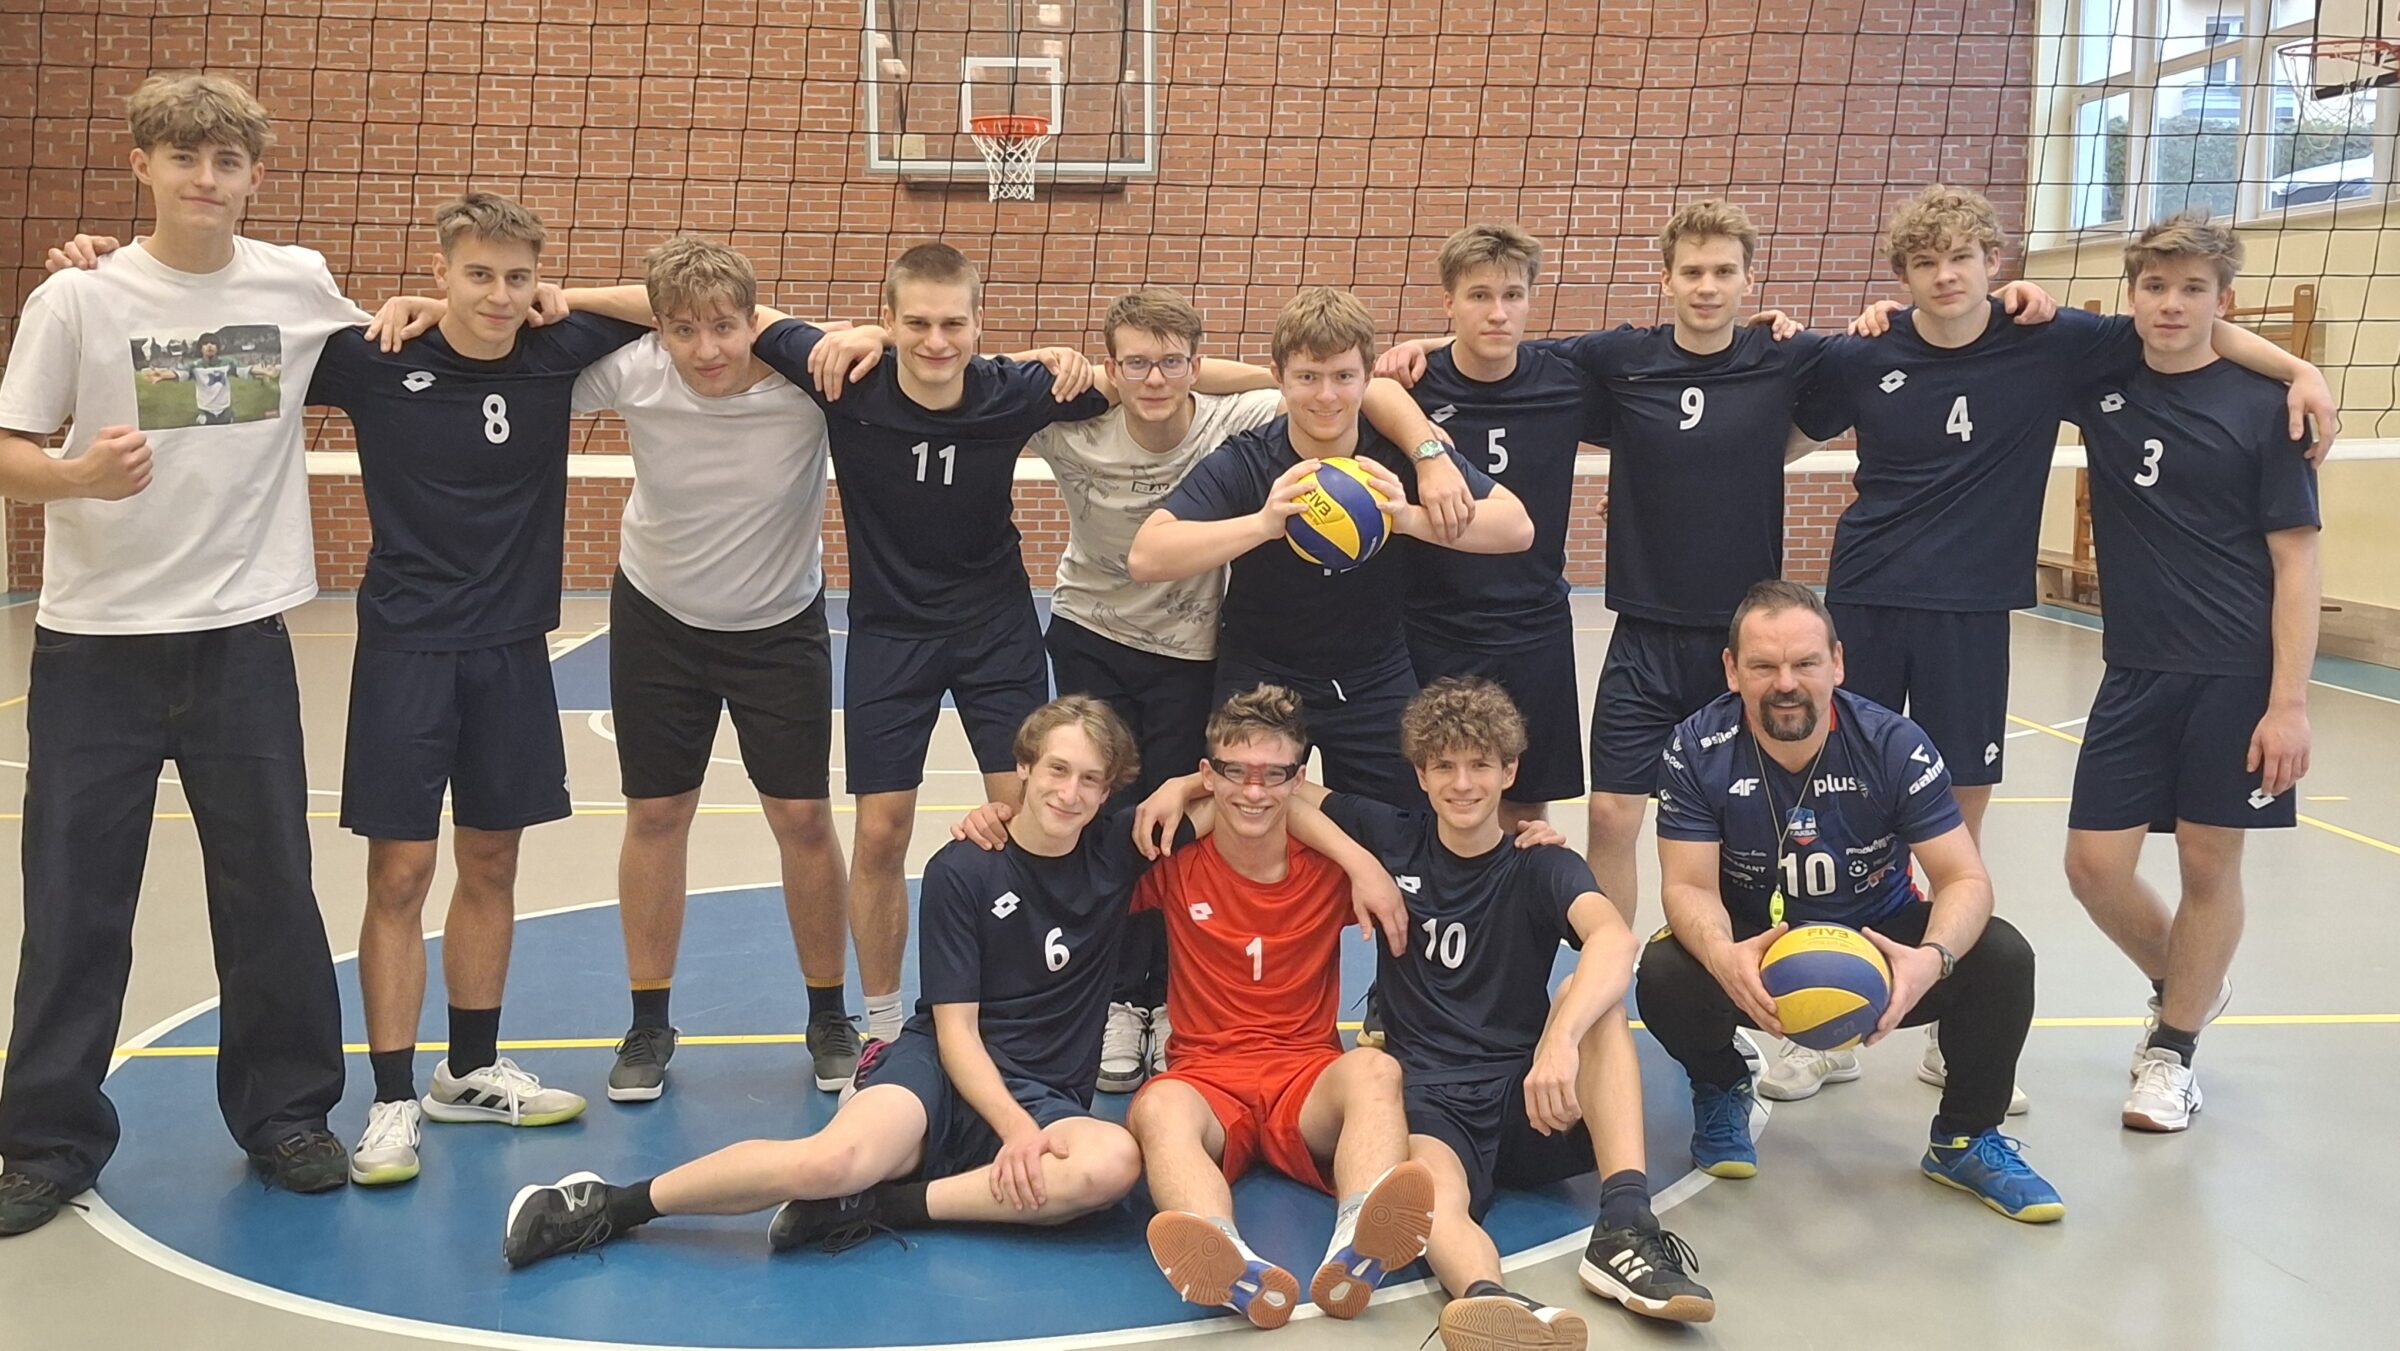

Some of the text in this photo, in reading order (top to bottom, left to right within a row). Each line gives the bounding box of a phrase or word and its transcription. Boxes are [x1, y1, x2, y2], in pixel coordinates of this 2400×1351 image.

[481, 393, 511, 444] 8
[1679, 386, 1705, 431] 9
[1945, 395, 1974, 442] 4
[911, 441, 956, 485] 11
[1487, 427, 1509, 474] 5
[2133, 438, 2164, 487] 3
[1728, 777, 1760, 797] 4F
[1813, 773, 1858, 798] plus
[1780, 852, 1836, 898] 10
[1044, 926, 1070, 972] 6
[1245, 936, 1263, 981] 1
[1421, 917, 1467, 969] 10
